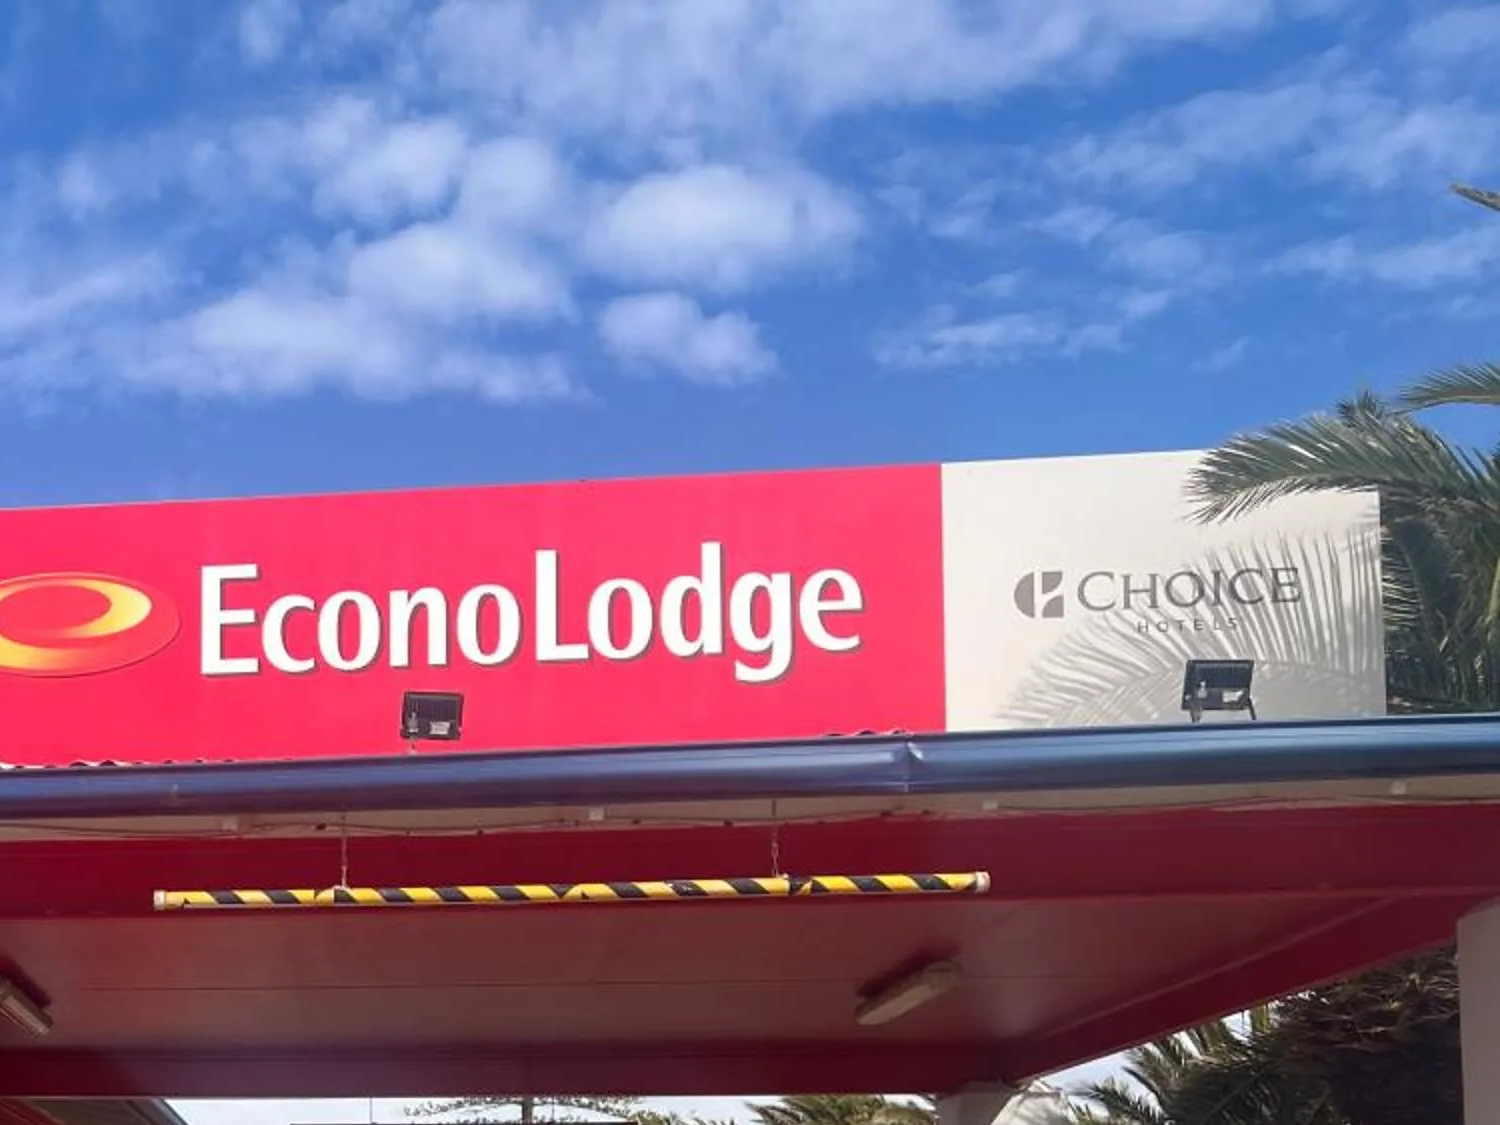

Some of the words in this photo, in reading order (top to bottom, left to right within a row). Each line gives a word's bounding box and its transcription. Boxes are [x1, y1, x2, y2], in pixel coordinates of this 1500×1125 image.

[1077, 567, 1301, 611] CHOICE
[200, 541, 864, 684] EconoLodge
[1137, 617, 1238, 633] HOTELS
